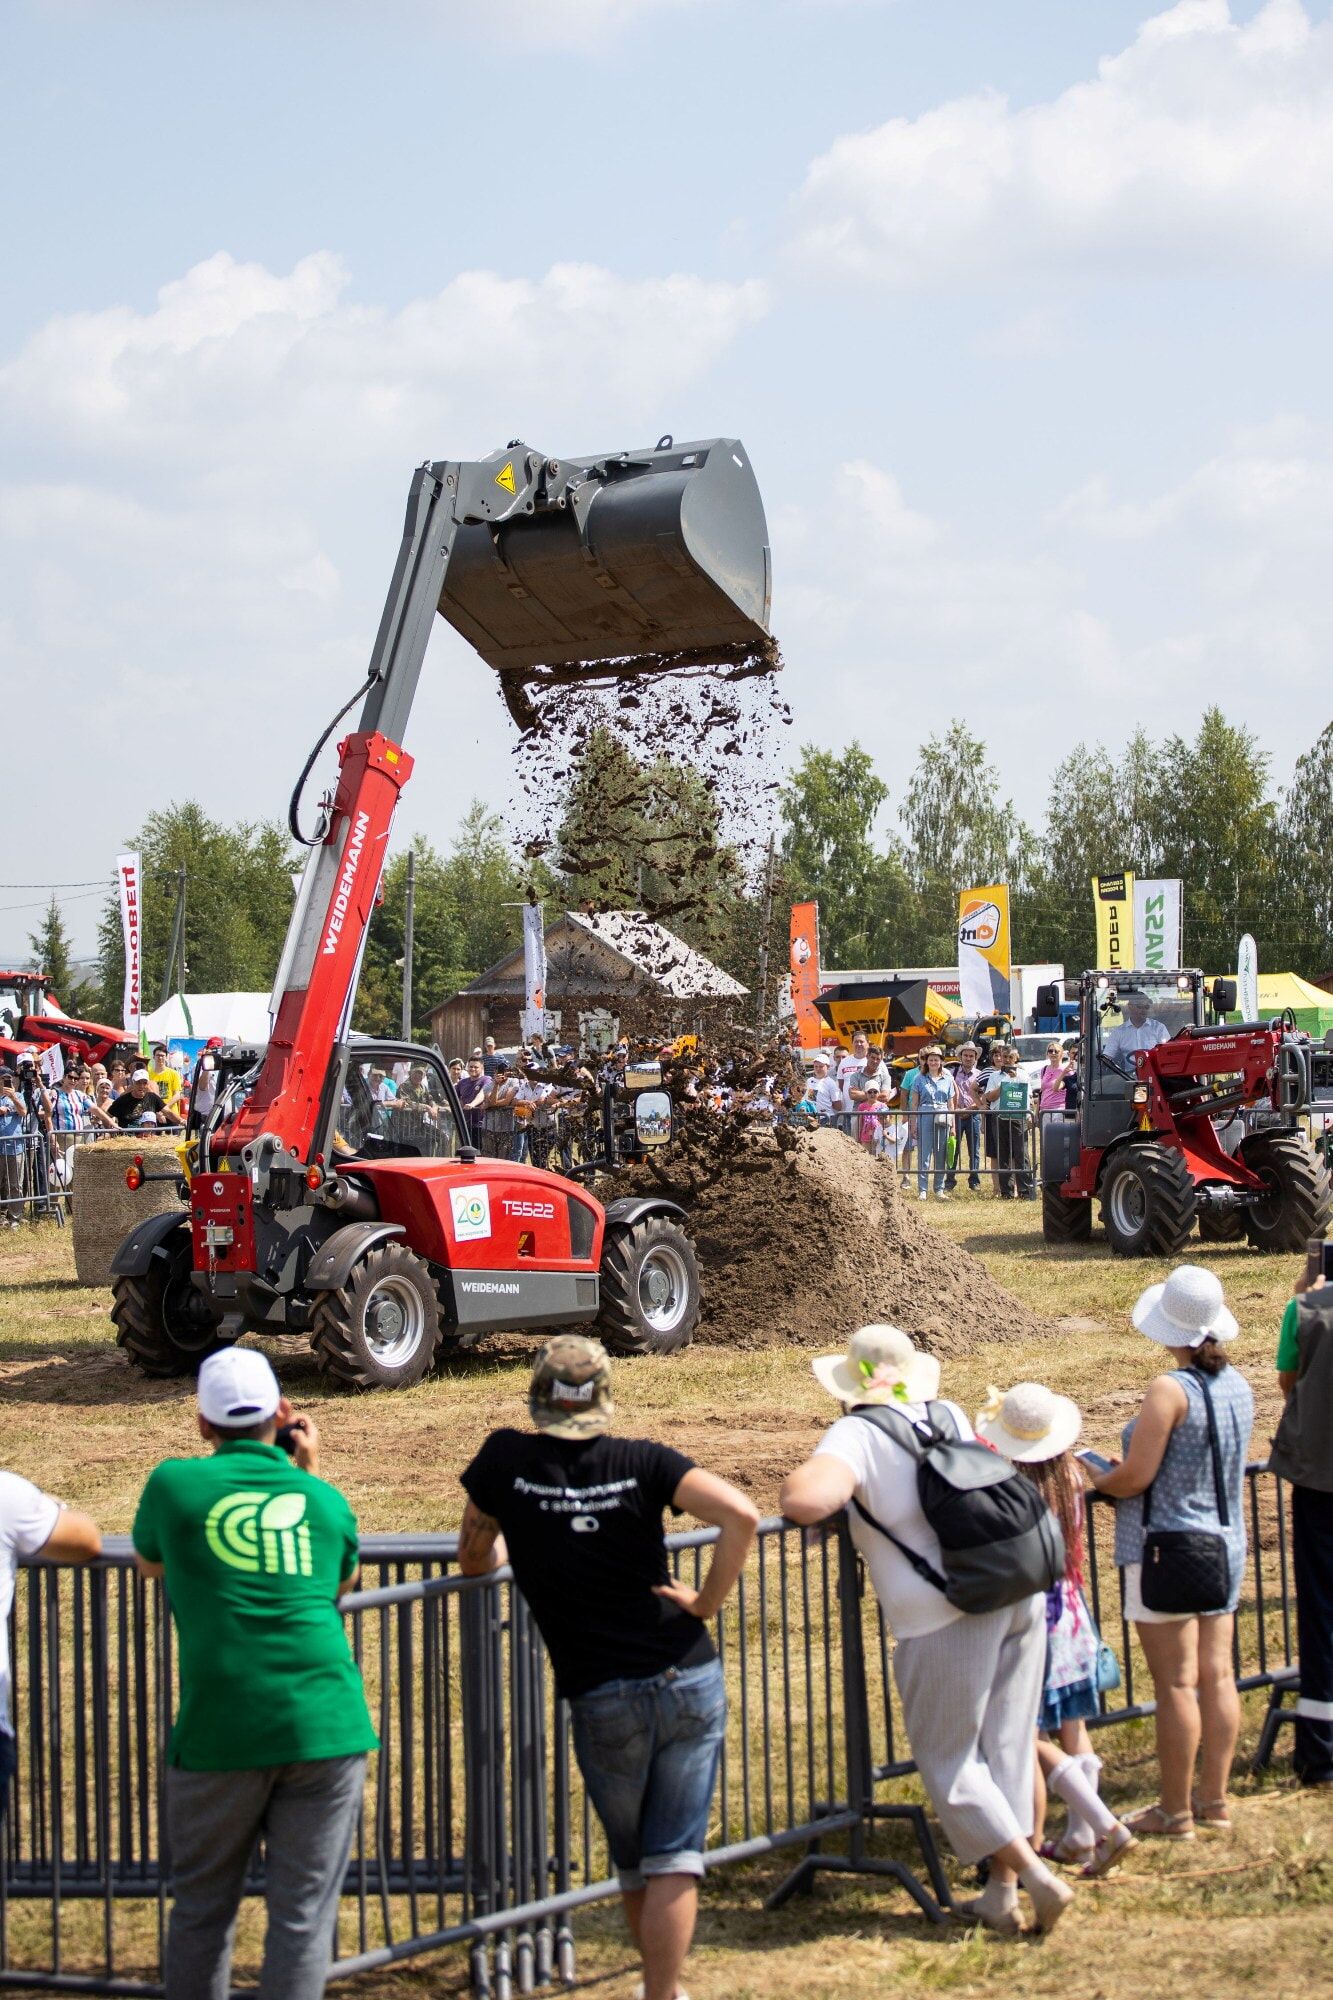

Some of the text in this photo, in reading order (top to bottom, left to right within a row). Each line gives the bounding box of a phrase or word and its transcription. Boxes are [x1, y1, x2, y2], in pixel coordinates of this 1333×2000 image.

[323, 811, 369, 955] WEIDEMANN
[928, 985, 960, 993] ДВИЖН
[1202, 1042, 1237, 1051] WEIDEMANN
[461, 1282, 520, 1294] WEIDEMANN
